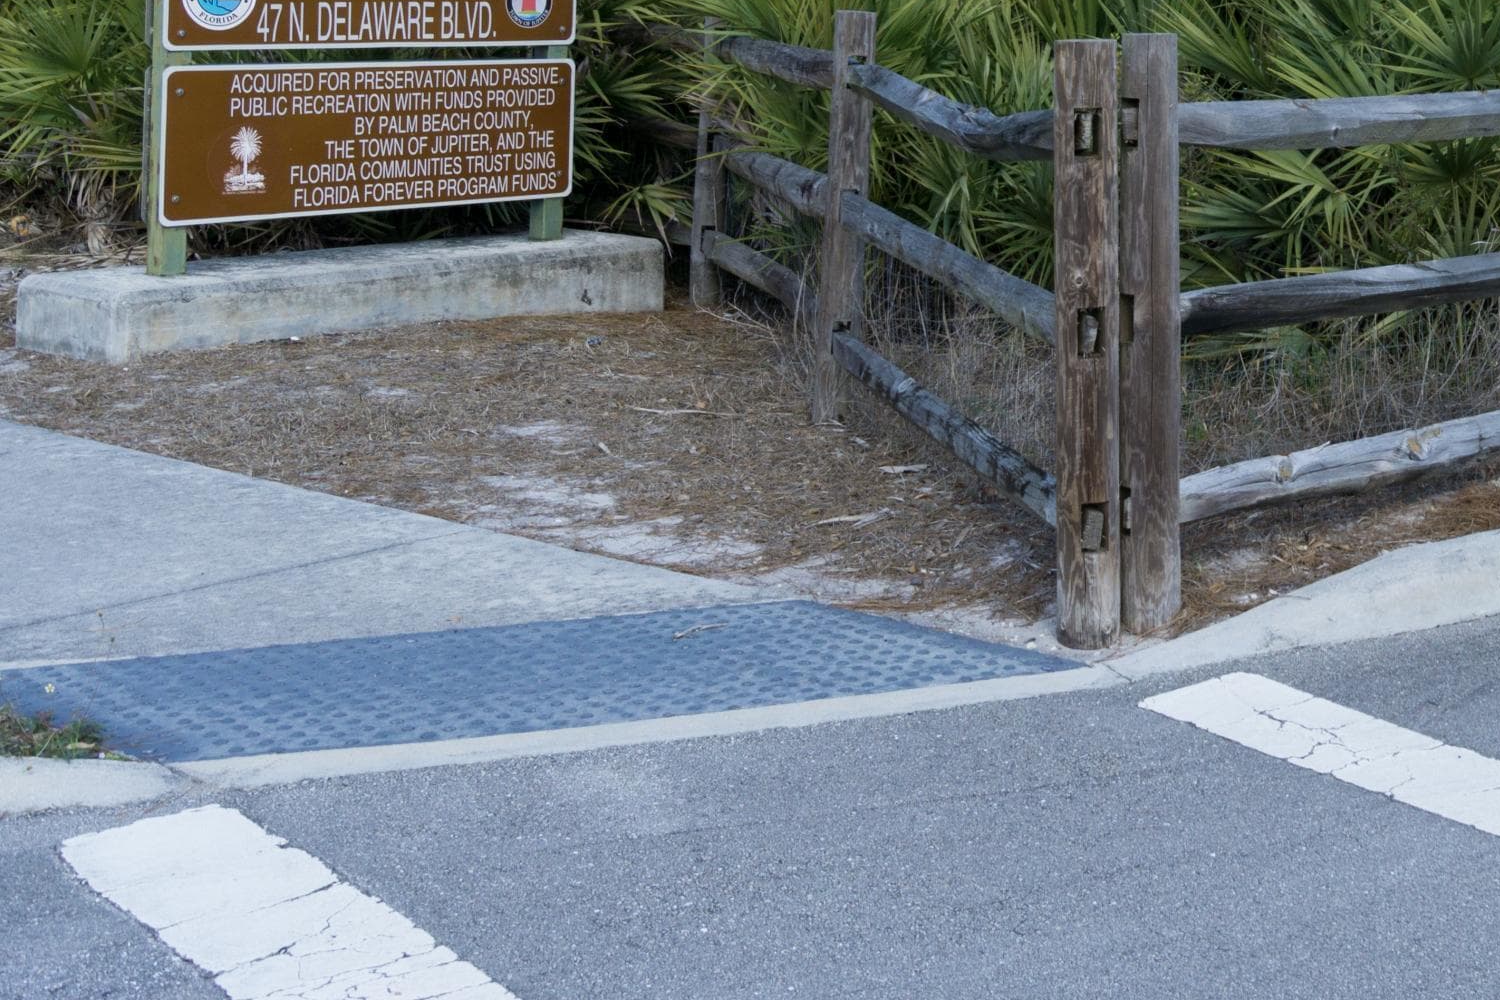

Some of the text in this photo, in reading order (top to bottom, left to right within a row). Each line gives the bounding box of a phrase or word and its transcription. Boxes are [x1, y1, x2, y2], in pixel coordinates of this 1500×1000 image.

[199, 11, 238, 24] FLORIDA
[257, 2, 496, 43] 47 N. DELAWARE BLVD.
[230, 68, 558, 94] ACQUIRED FOR PRESERVATION AND PASSIVE
[230, 88, 555, 117] PUBLIC RECREATION WITH FUNDS PROVIDED
[355, 111, 534, 136] BY PALM BEACH COUNTY,
[325, 130, 554, 160] THE TOWN OF JUPITER, AND THE
[291, 151, 556, 185] FLORIDA COMMUNITIES TRUST USING
[294, 173, 557, 208] FLORIDA FOREVER PROGRAM FUNDS
